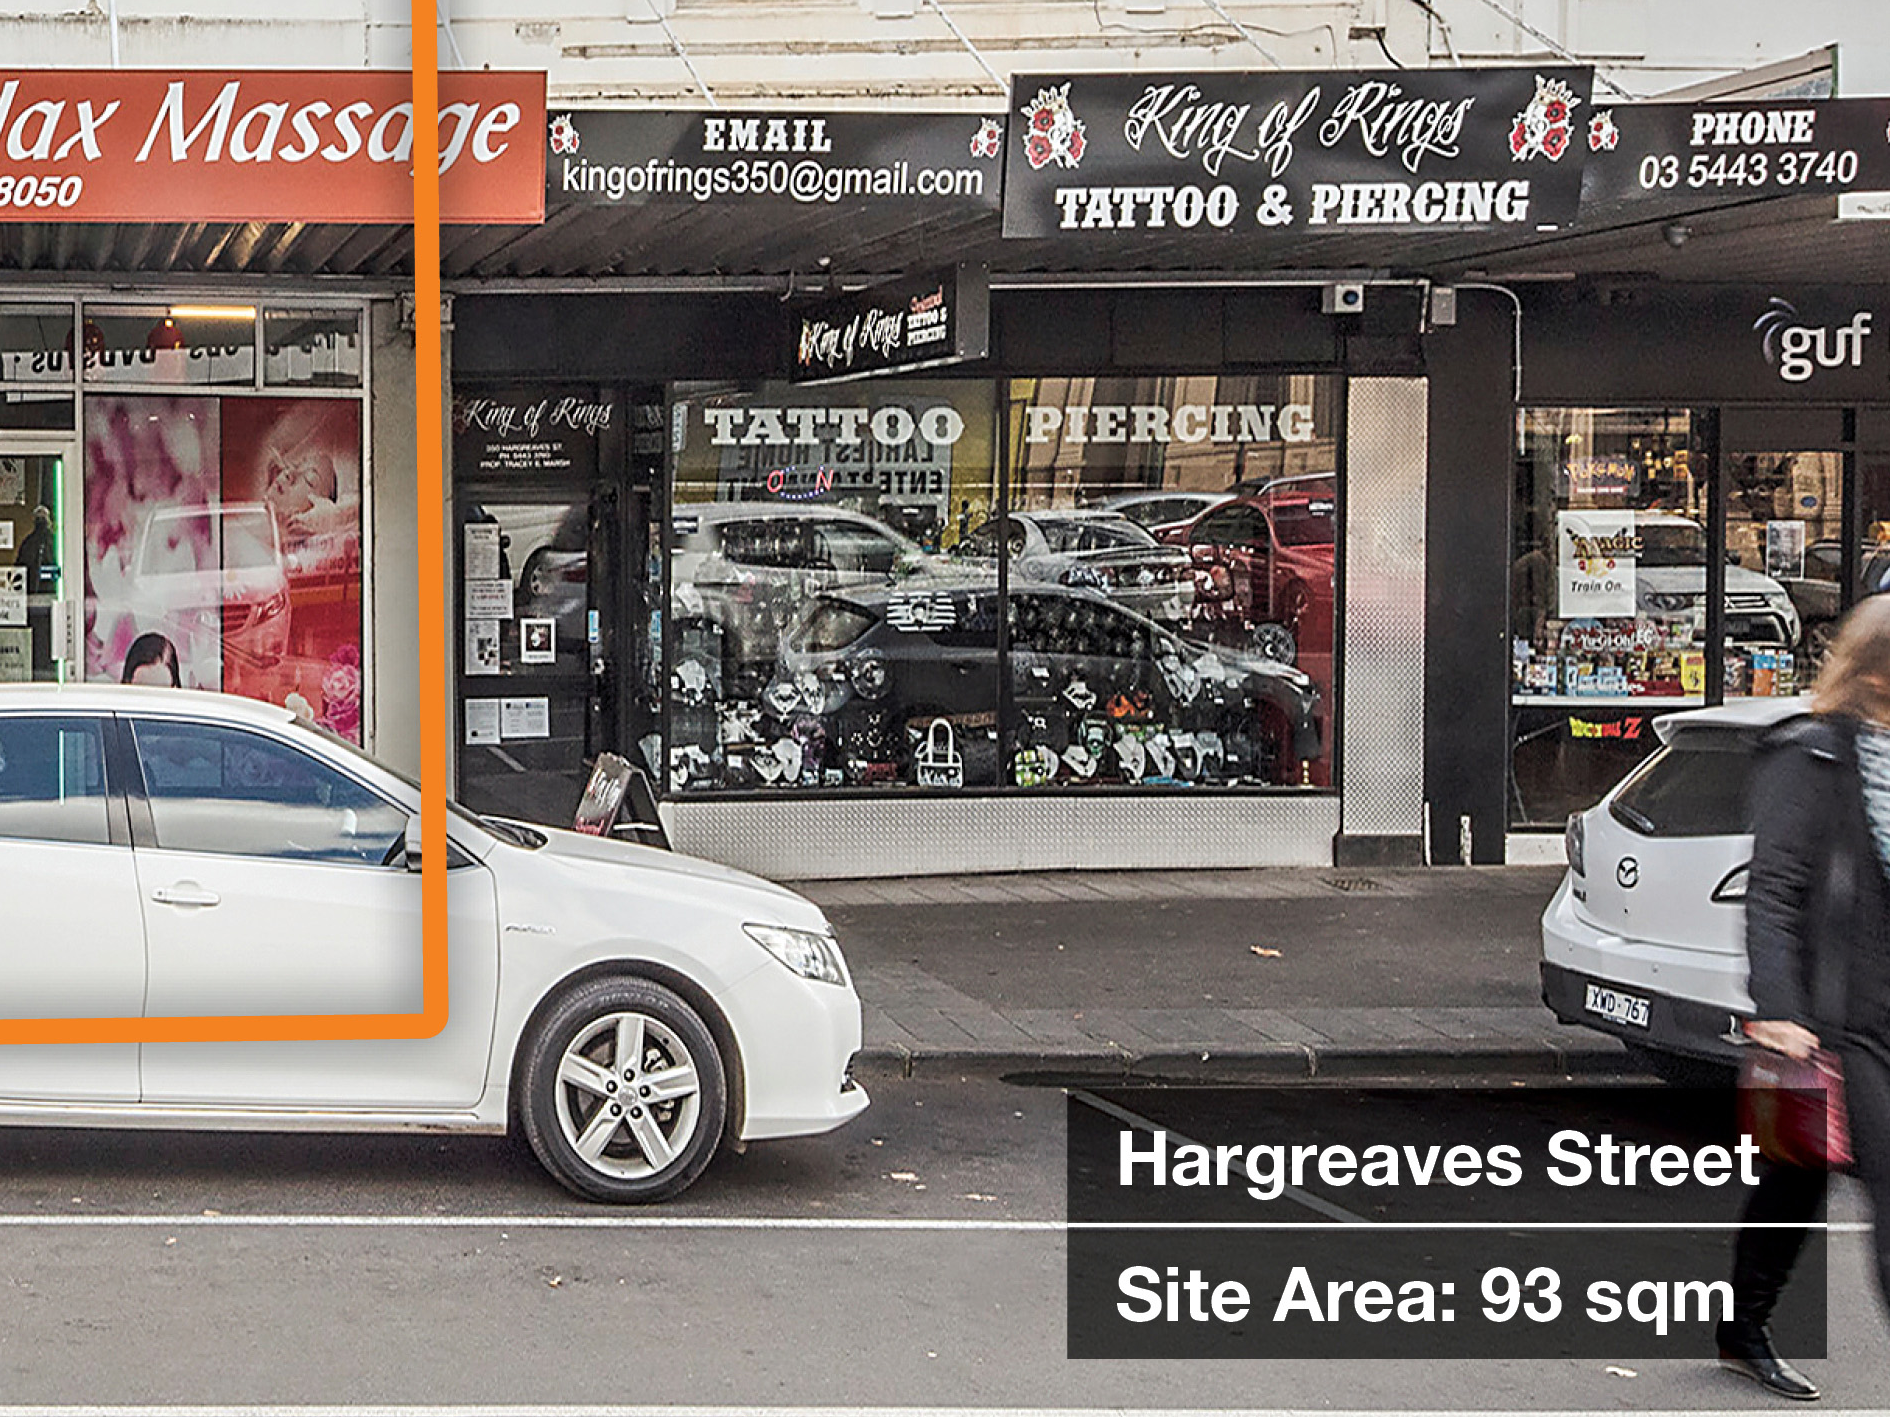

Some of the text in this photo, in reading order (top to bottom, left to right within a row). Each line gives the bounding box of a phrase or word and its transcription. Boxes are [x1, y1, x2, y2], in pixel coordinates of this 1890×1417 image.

[135, 80, 521, 177] Massage
[702, 119, 833, 153] EMAIL
[1124, 80, 1477, 179] King of Rings
[1689, 110, 1816, 146] PHONE
[562, 158, 984, 203] kingofrings350@gmail.com
[1639, 150, 1858, 189] 03 5443 3740
[1055, 180, 1530, 230] TATTOO & PIERCING
[1778, 311, 1873, 382] guf
[464, 395, 613, 438] King of Rings
[704, 406, 965, 445] TATTOO
[1024, 404, 1317, 444] PIERCING
